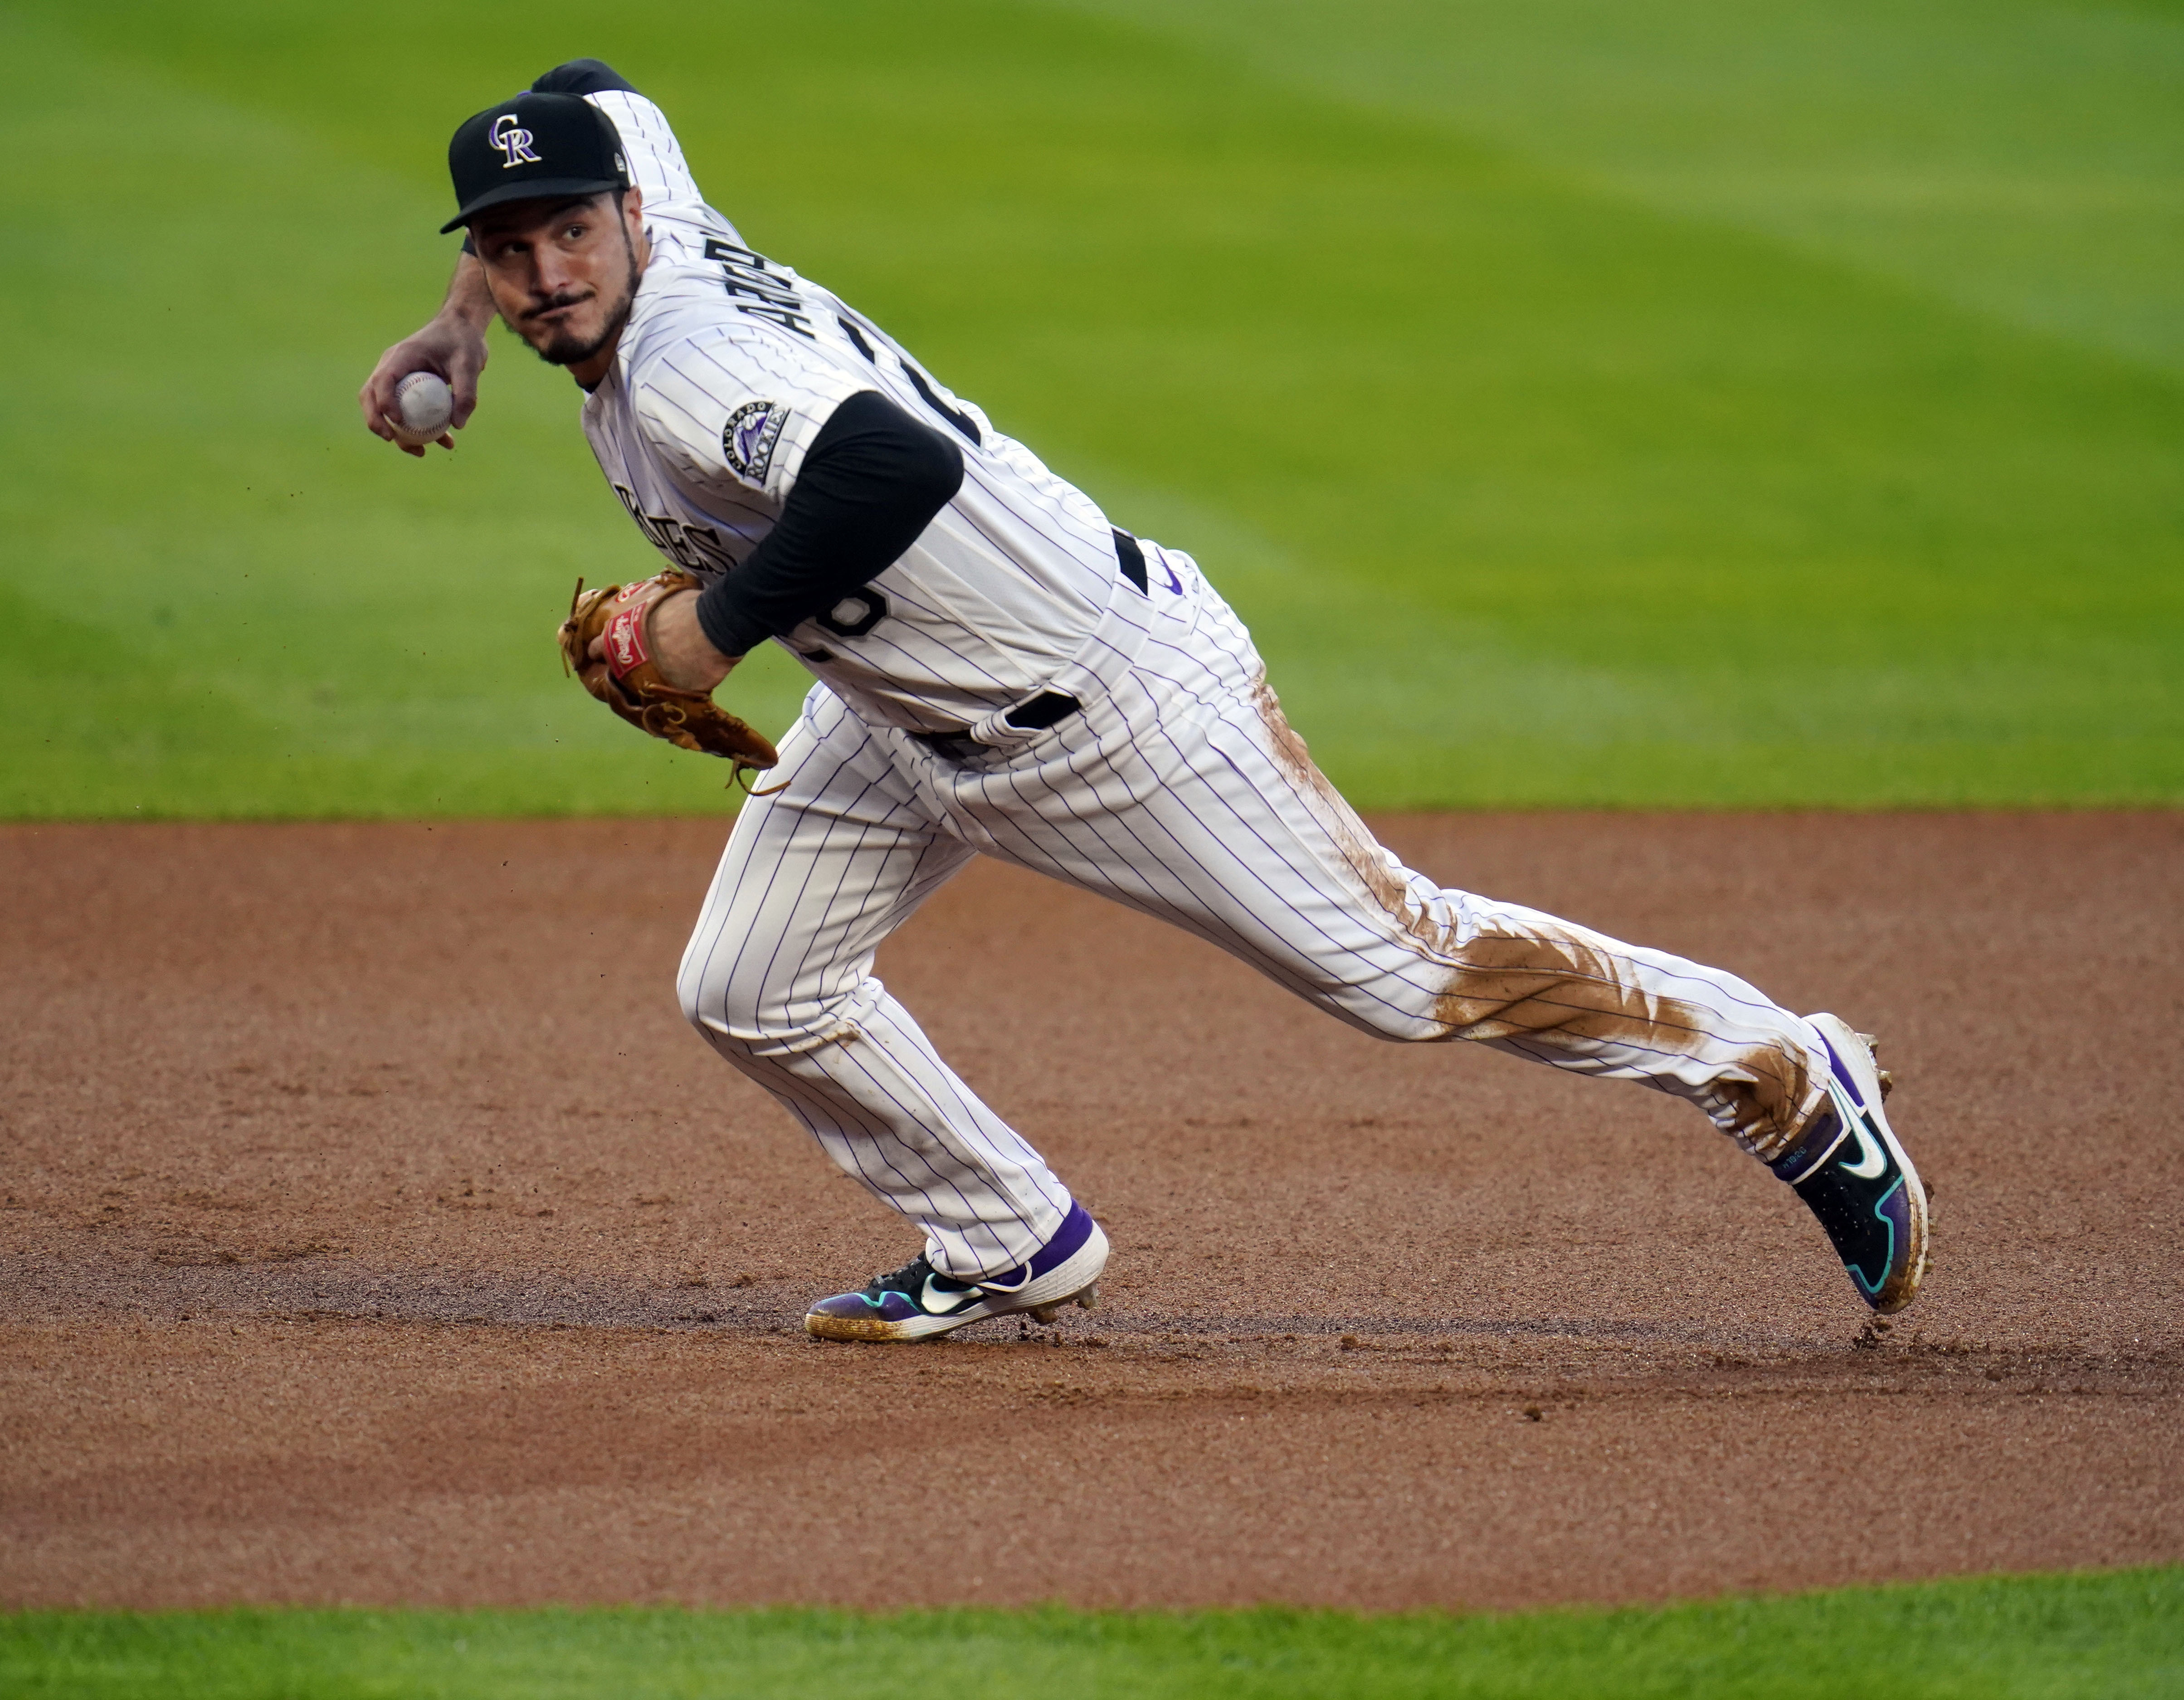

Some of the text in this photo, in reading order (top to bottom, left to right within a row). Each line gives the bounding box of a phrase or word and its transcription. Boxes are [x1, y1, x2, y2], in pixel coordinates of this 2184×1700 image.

[488, 113, 542, 169] CR
[723, 401, 766, 470] COLORADO
[746, 406, 785, 481] ROCKIES
